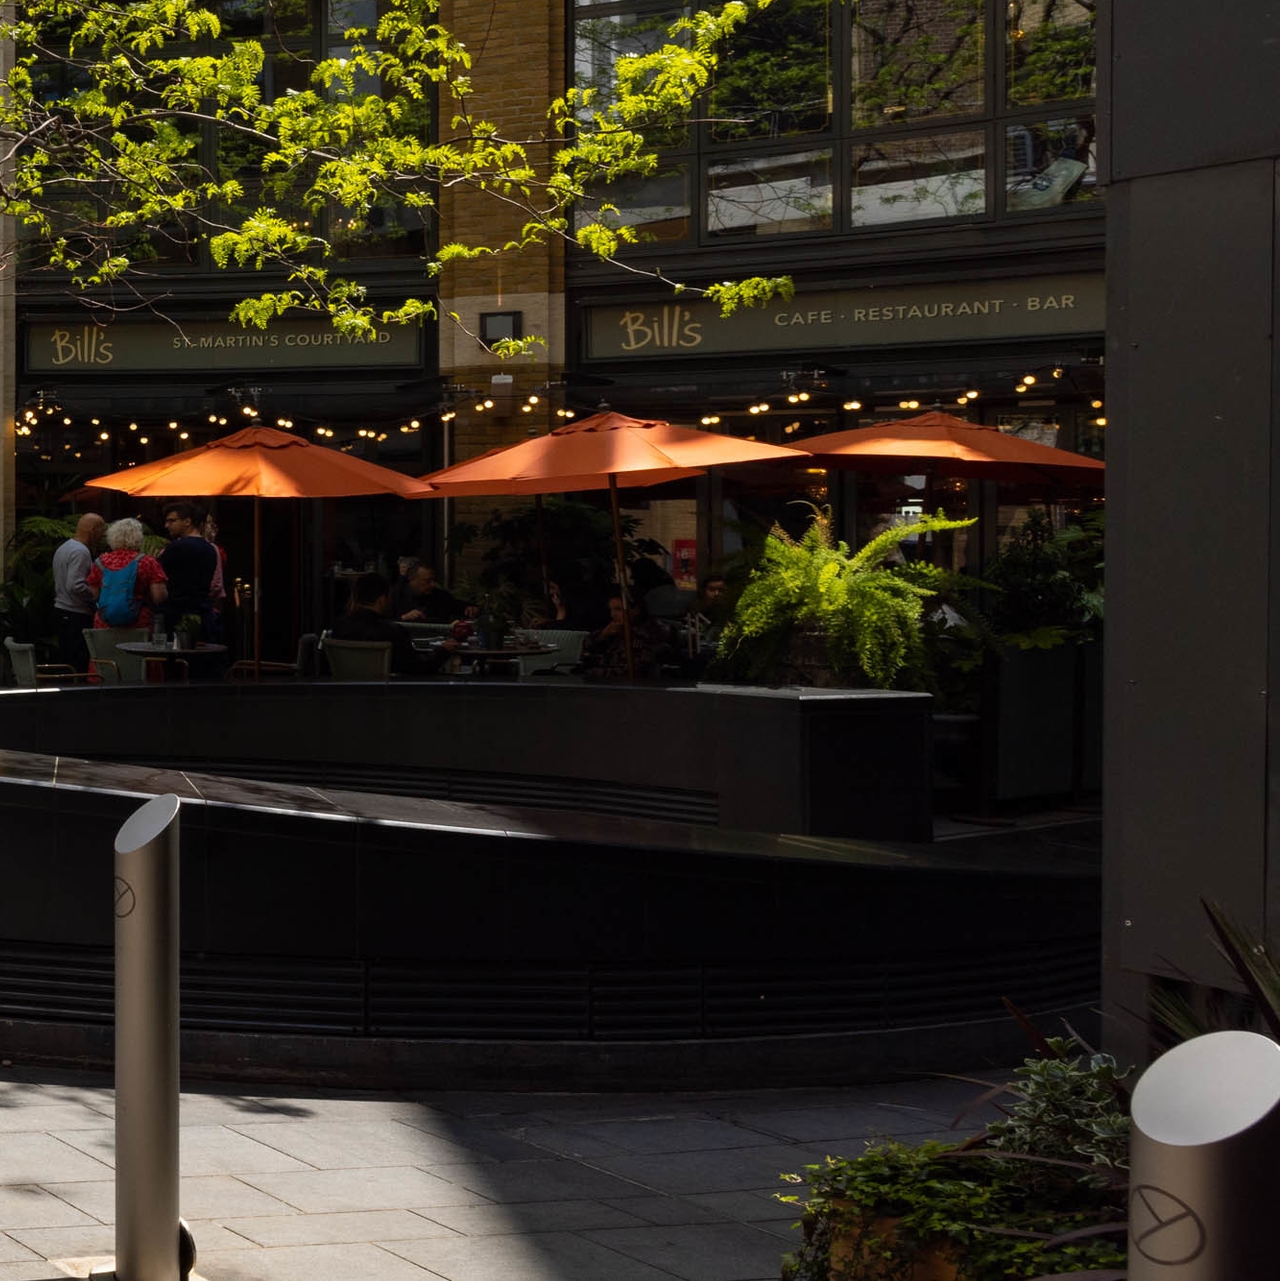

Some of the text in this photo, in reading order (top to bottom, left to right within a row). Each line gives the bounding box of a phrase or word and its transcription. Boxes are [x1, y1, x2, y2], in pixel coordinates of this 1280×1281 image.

[619, 305, 703, 351] Bill's
[774, 294, 1076, 327] CAFE RESTAURANT BAR
[51, 325, 114, 365] Bill's
[200, 334, 279, 348] MARTIN'S
